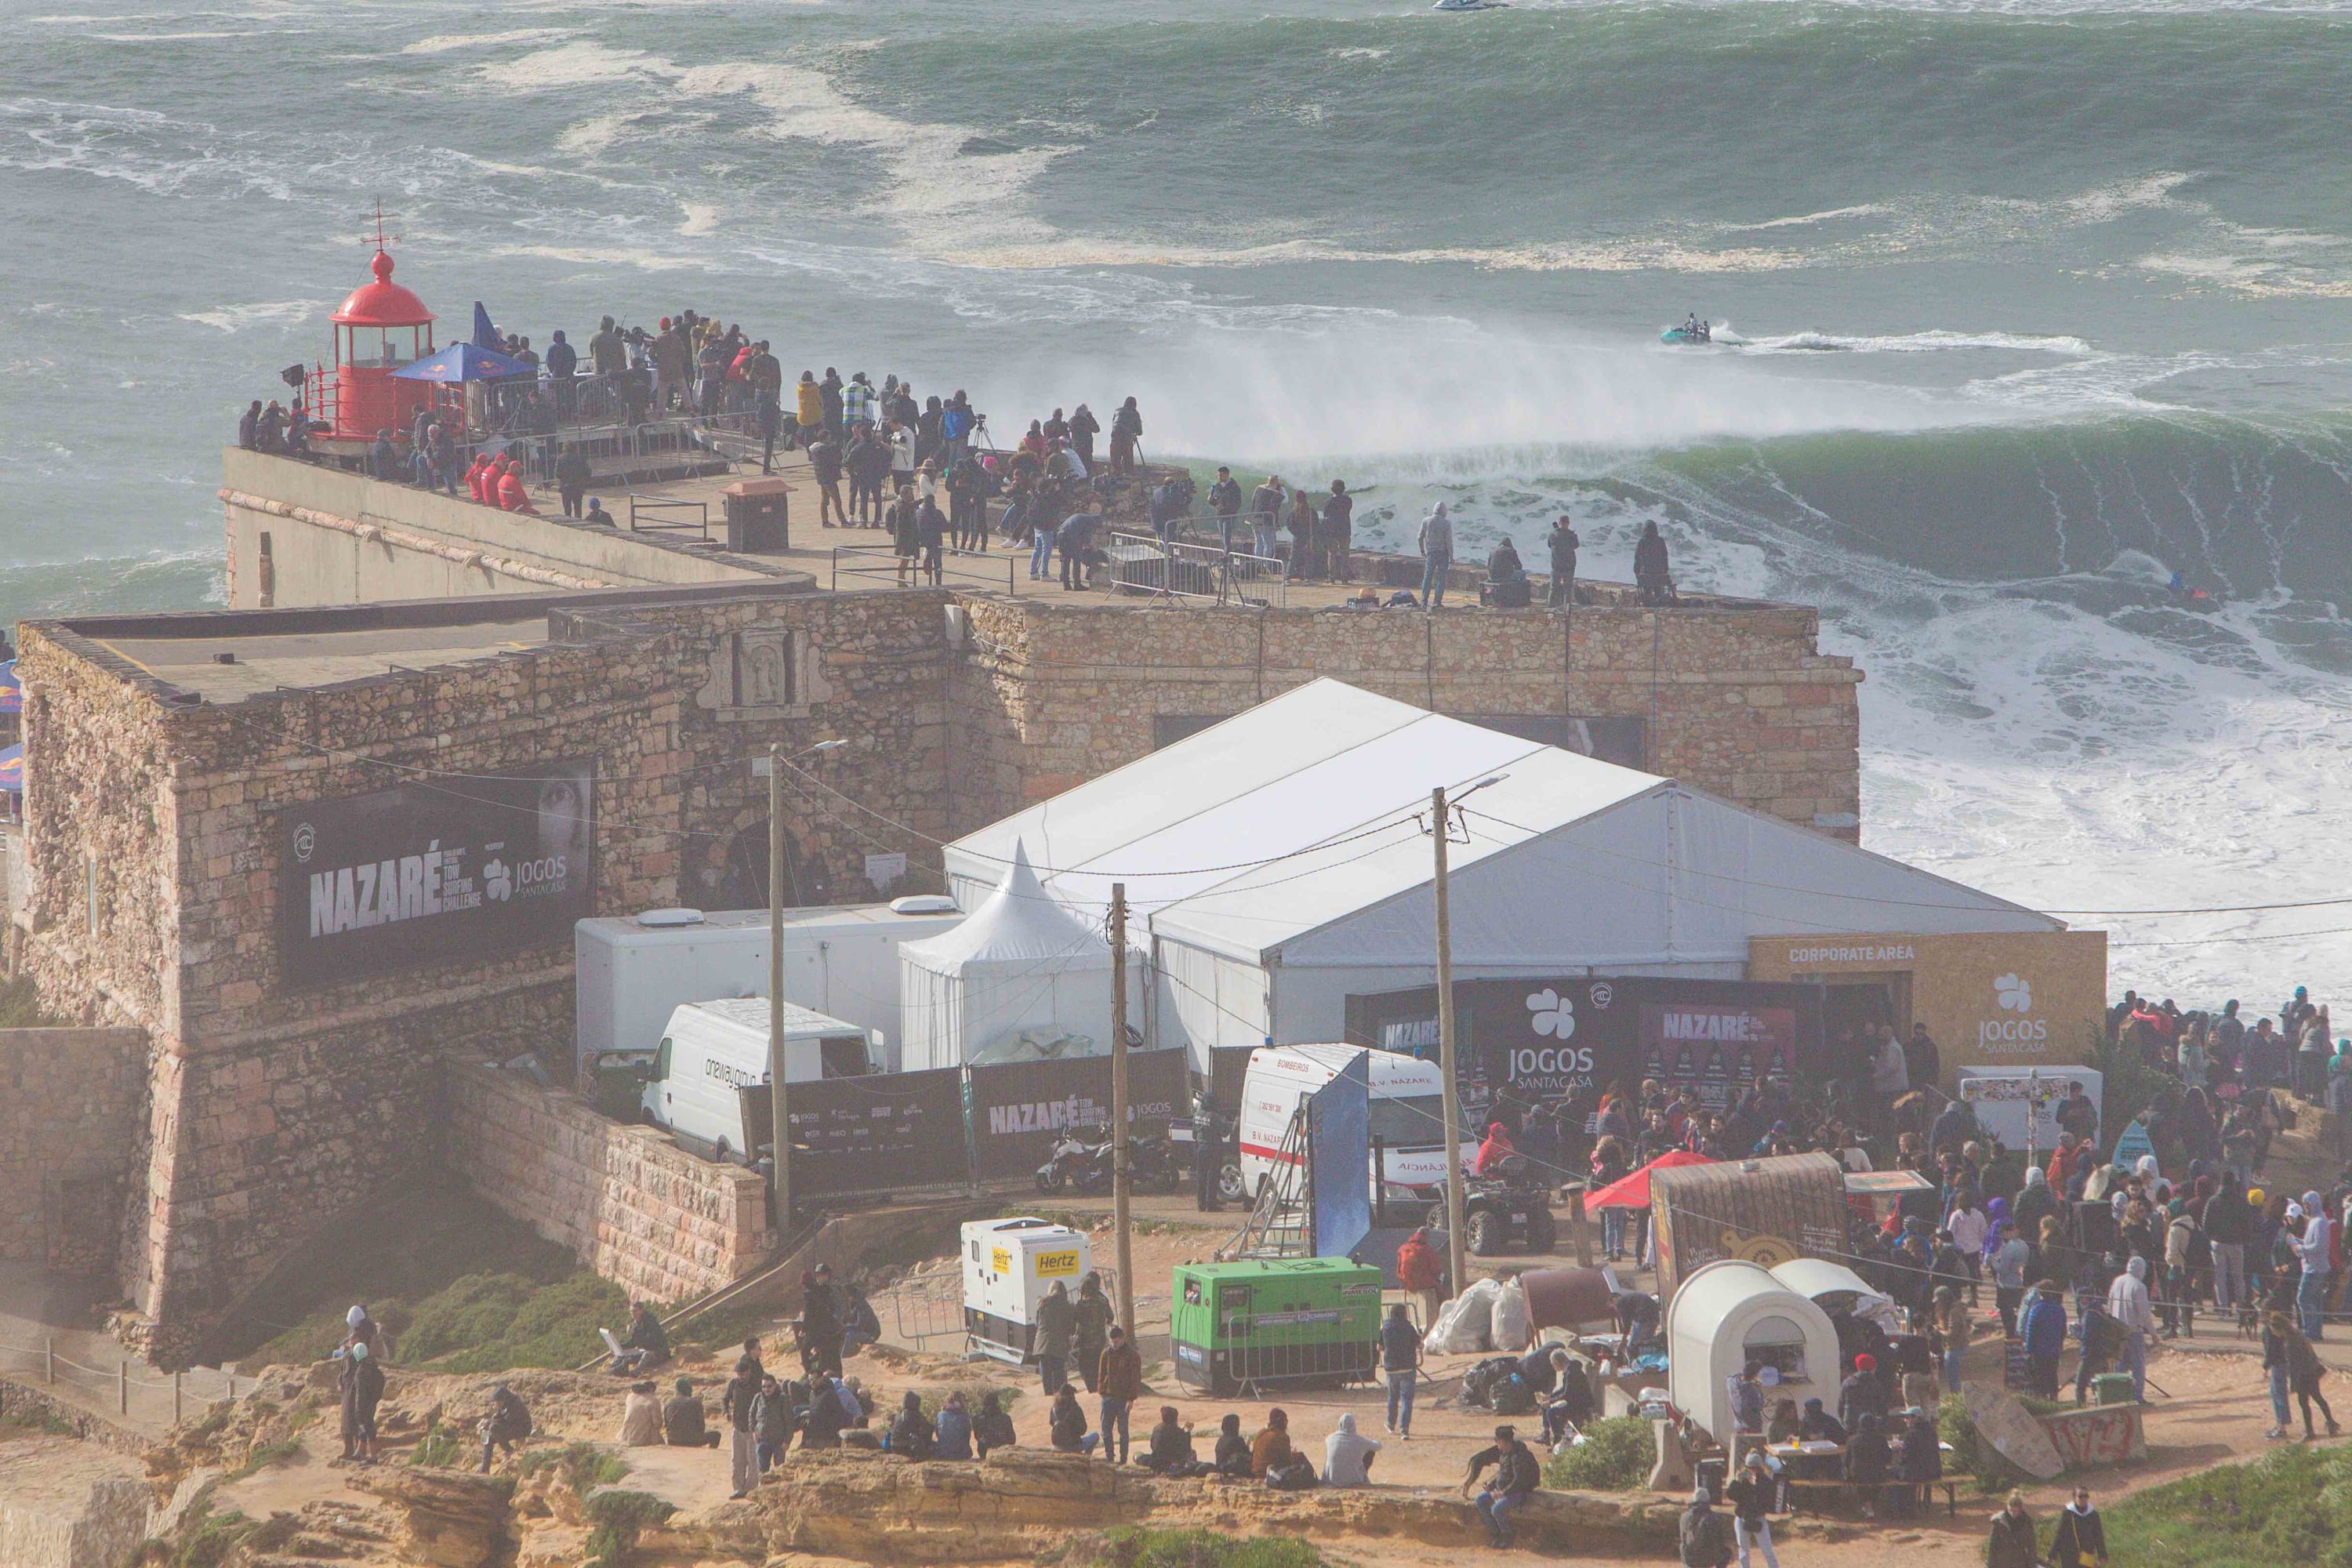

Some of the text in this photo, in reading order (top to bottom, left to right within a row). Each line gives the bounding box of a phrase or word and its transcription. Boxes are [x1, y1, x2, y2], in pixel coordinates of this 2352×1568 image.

[444, 864, 460, 880] TOW
[516, 855, 567, 894] JOGOS
[310, 839, 441, 938] NAZARÉ
[444, 877, 474, 896] SURFING
[444, 891, 482, 913] CHALLENGE
[1790, 944, 1915, 963] CORPORATE AREA
[1664, 1011, 1750, 1042] NAZARÉ
[1978, 1019, 2047, 1048] JOGOS
[1276, 1058, 1310, 1073] BOMBEIROS
[1508, 1047, 1594, 1083] JOGOS
[1079, 1098, 1094, 1108] TOW
[1080, 1106, 1106, 1119] SURFING
[1137, 1102, 1171, 1118] JOGOS
[989, 1093, 1080, 1135] NAZARÉ
[993, 1250, 1008, 1266] Hertz
[1040, 1254, 1075, 1269] Hertz
